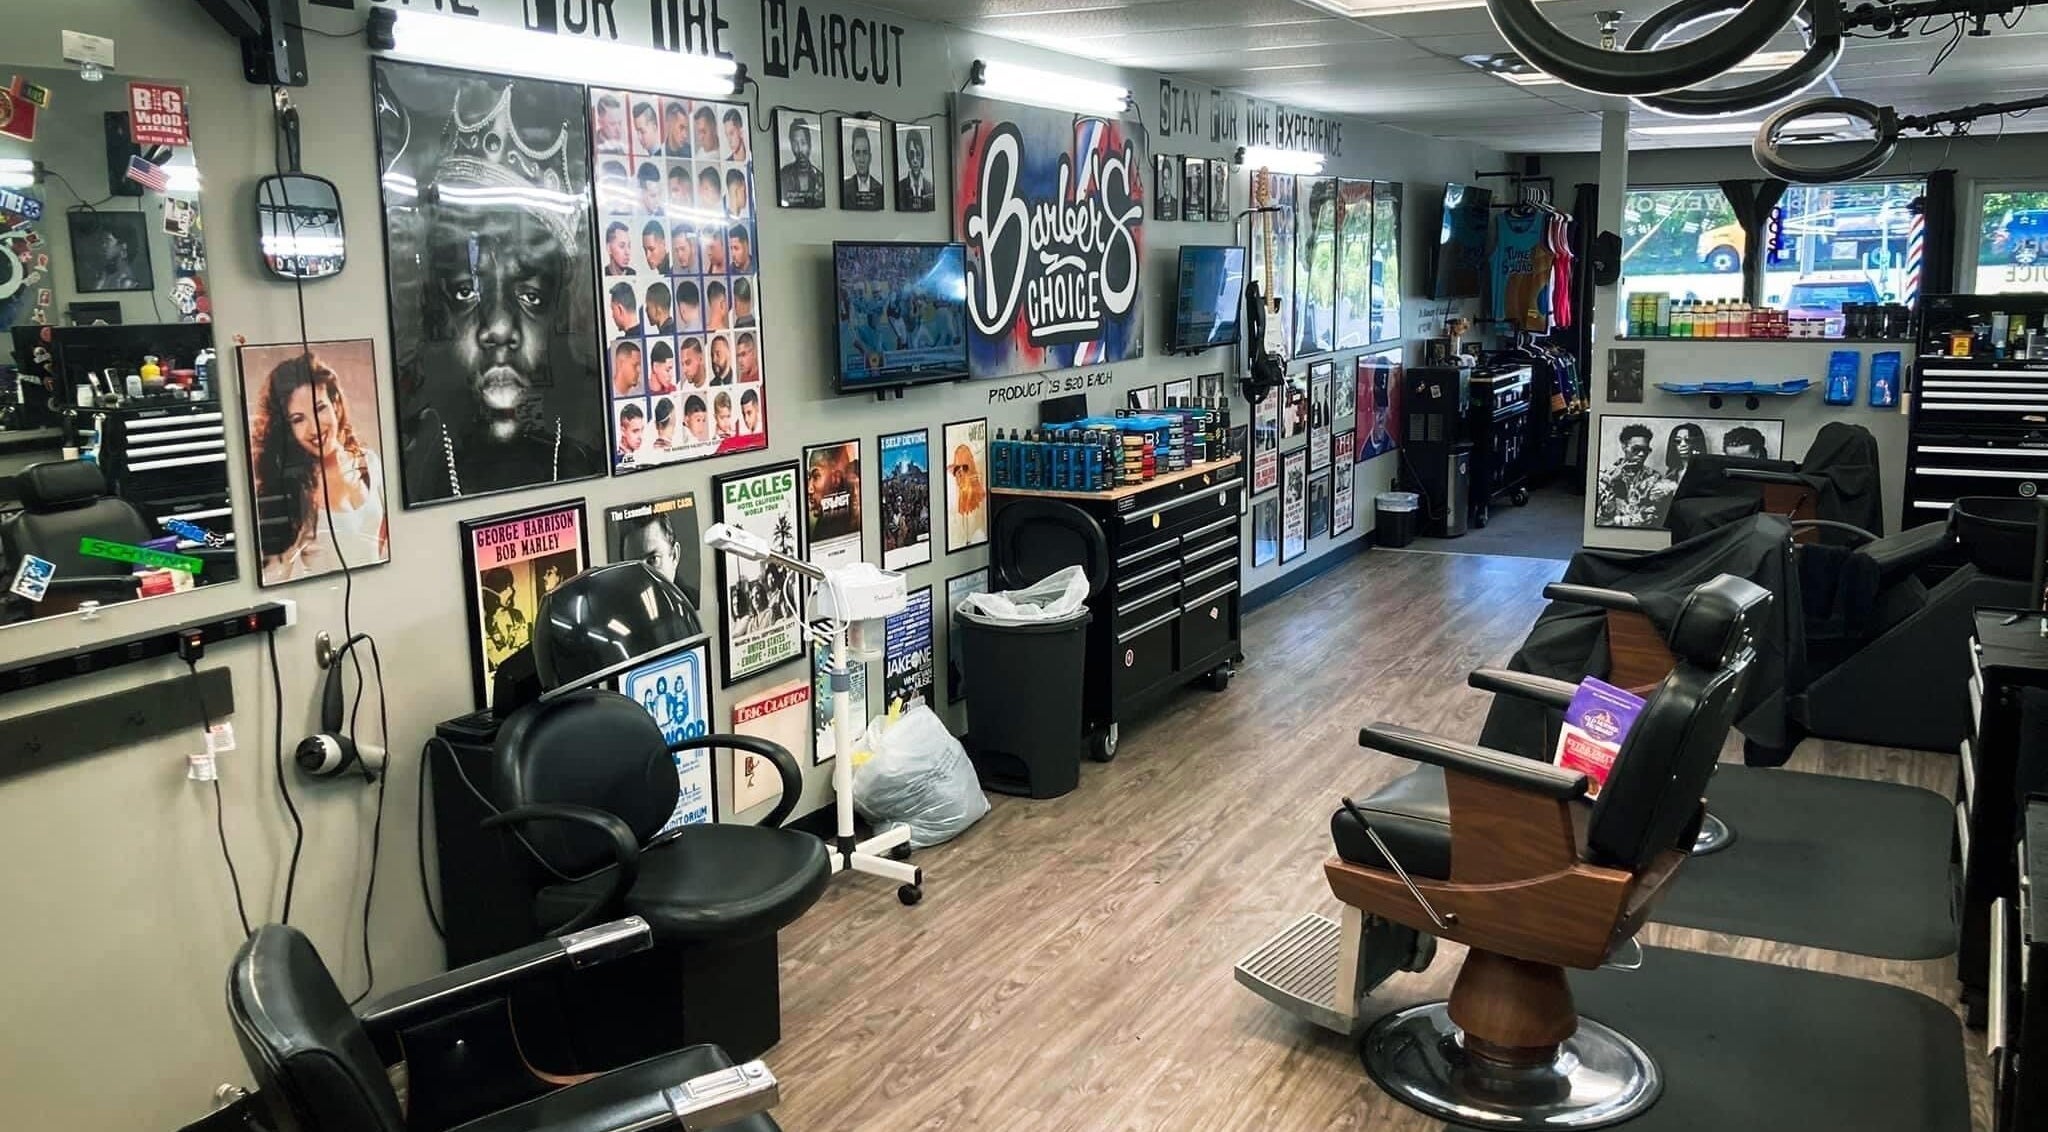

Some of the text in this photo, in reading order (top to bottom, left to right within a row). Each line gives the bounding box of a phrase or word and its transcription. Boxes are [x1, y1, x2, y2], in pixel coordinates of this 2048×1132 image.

[761, 0, 905, 88] HAIRCUT
[135, 111, 182, 127] WOOD
[1160, 78, 1343, 157] STAY FOR THE EXPERIENCE
[1028, 271, 1100, 326] CHOICE
[988, 379, 1043, 404] PRODUCT
[1048, 379, 1060, 394] IS
[1087, 370, 1112, 387] EACH
[725, 473, 792, 504] EAGLES
[611, 511, 623, 521] The
[744, 503, 778, 517] WORLD TOUR
[476, 510, 575, 548] GEORGE HARRISON
[495, 532, 560, 562] BOB MARLEY
[741, 641, 791, 667] EUROPE FAR EAST
[767, 633, 785, 648] STATES
[736, 689, 808, 722] ERIC CLAPTON
